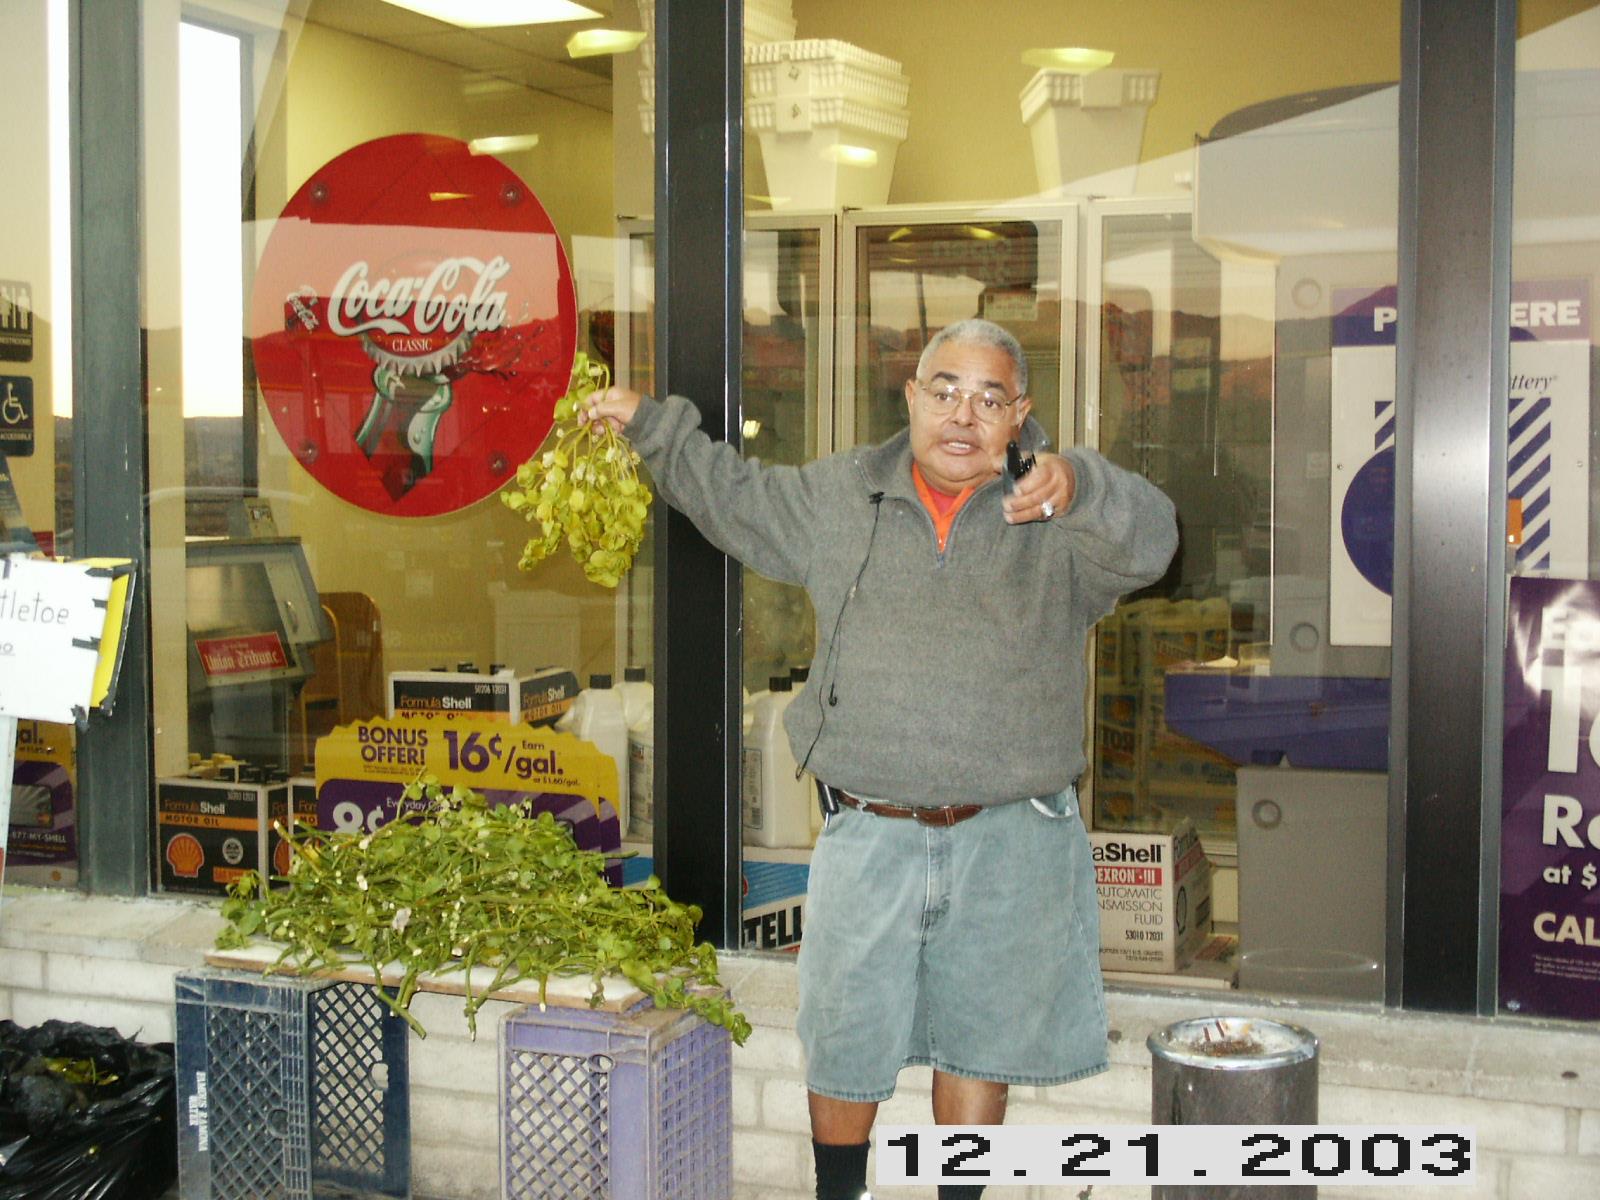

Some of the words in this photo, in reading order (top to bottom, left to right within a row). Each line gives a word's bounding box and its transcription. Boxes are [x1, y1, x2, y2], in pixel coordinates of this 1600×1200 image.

[327, 255, 510, 336] Coca-Cola
[1511, 300, 1580, 327] ERE
[392, 338, 433, 351] CLASSIC
[1511, 374, 1553, 394] ttery
[0, 590, 69, 625] tletoe
[358, 726, 428, 747] BONUS
[522, 740, 545, 750] Earn
[361, 745, 425, 766] OFFER!
[386, 796, 426, 812] Evyday
[165, 814, 199, 825] MOTOR
[203, 817, 220, 827] OIL
[1090, 842, 1162, 863] aShell
[1095, 867, 1135, 884] EXRON
[1543, 864, 1572, 885] at
[1098, 900, 1163, 912] NSMISSION
[1134, 914, 1163, 925] FLUID
